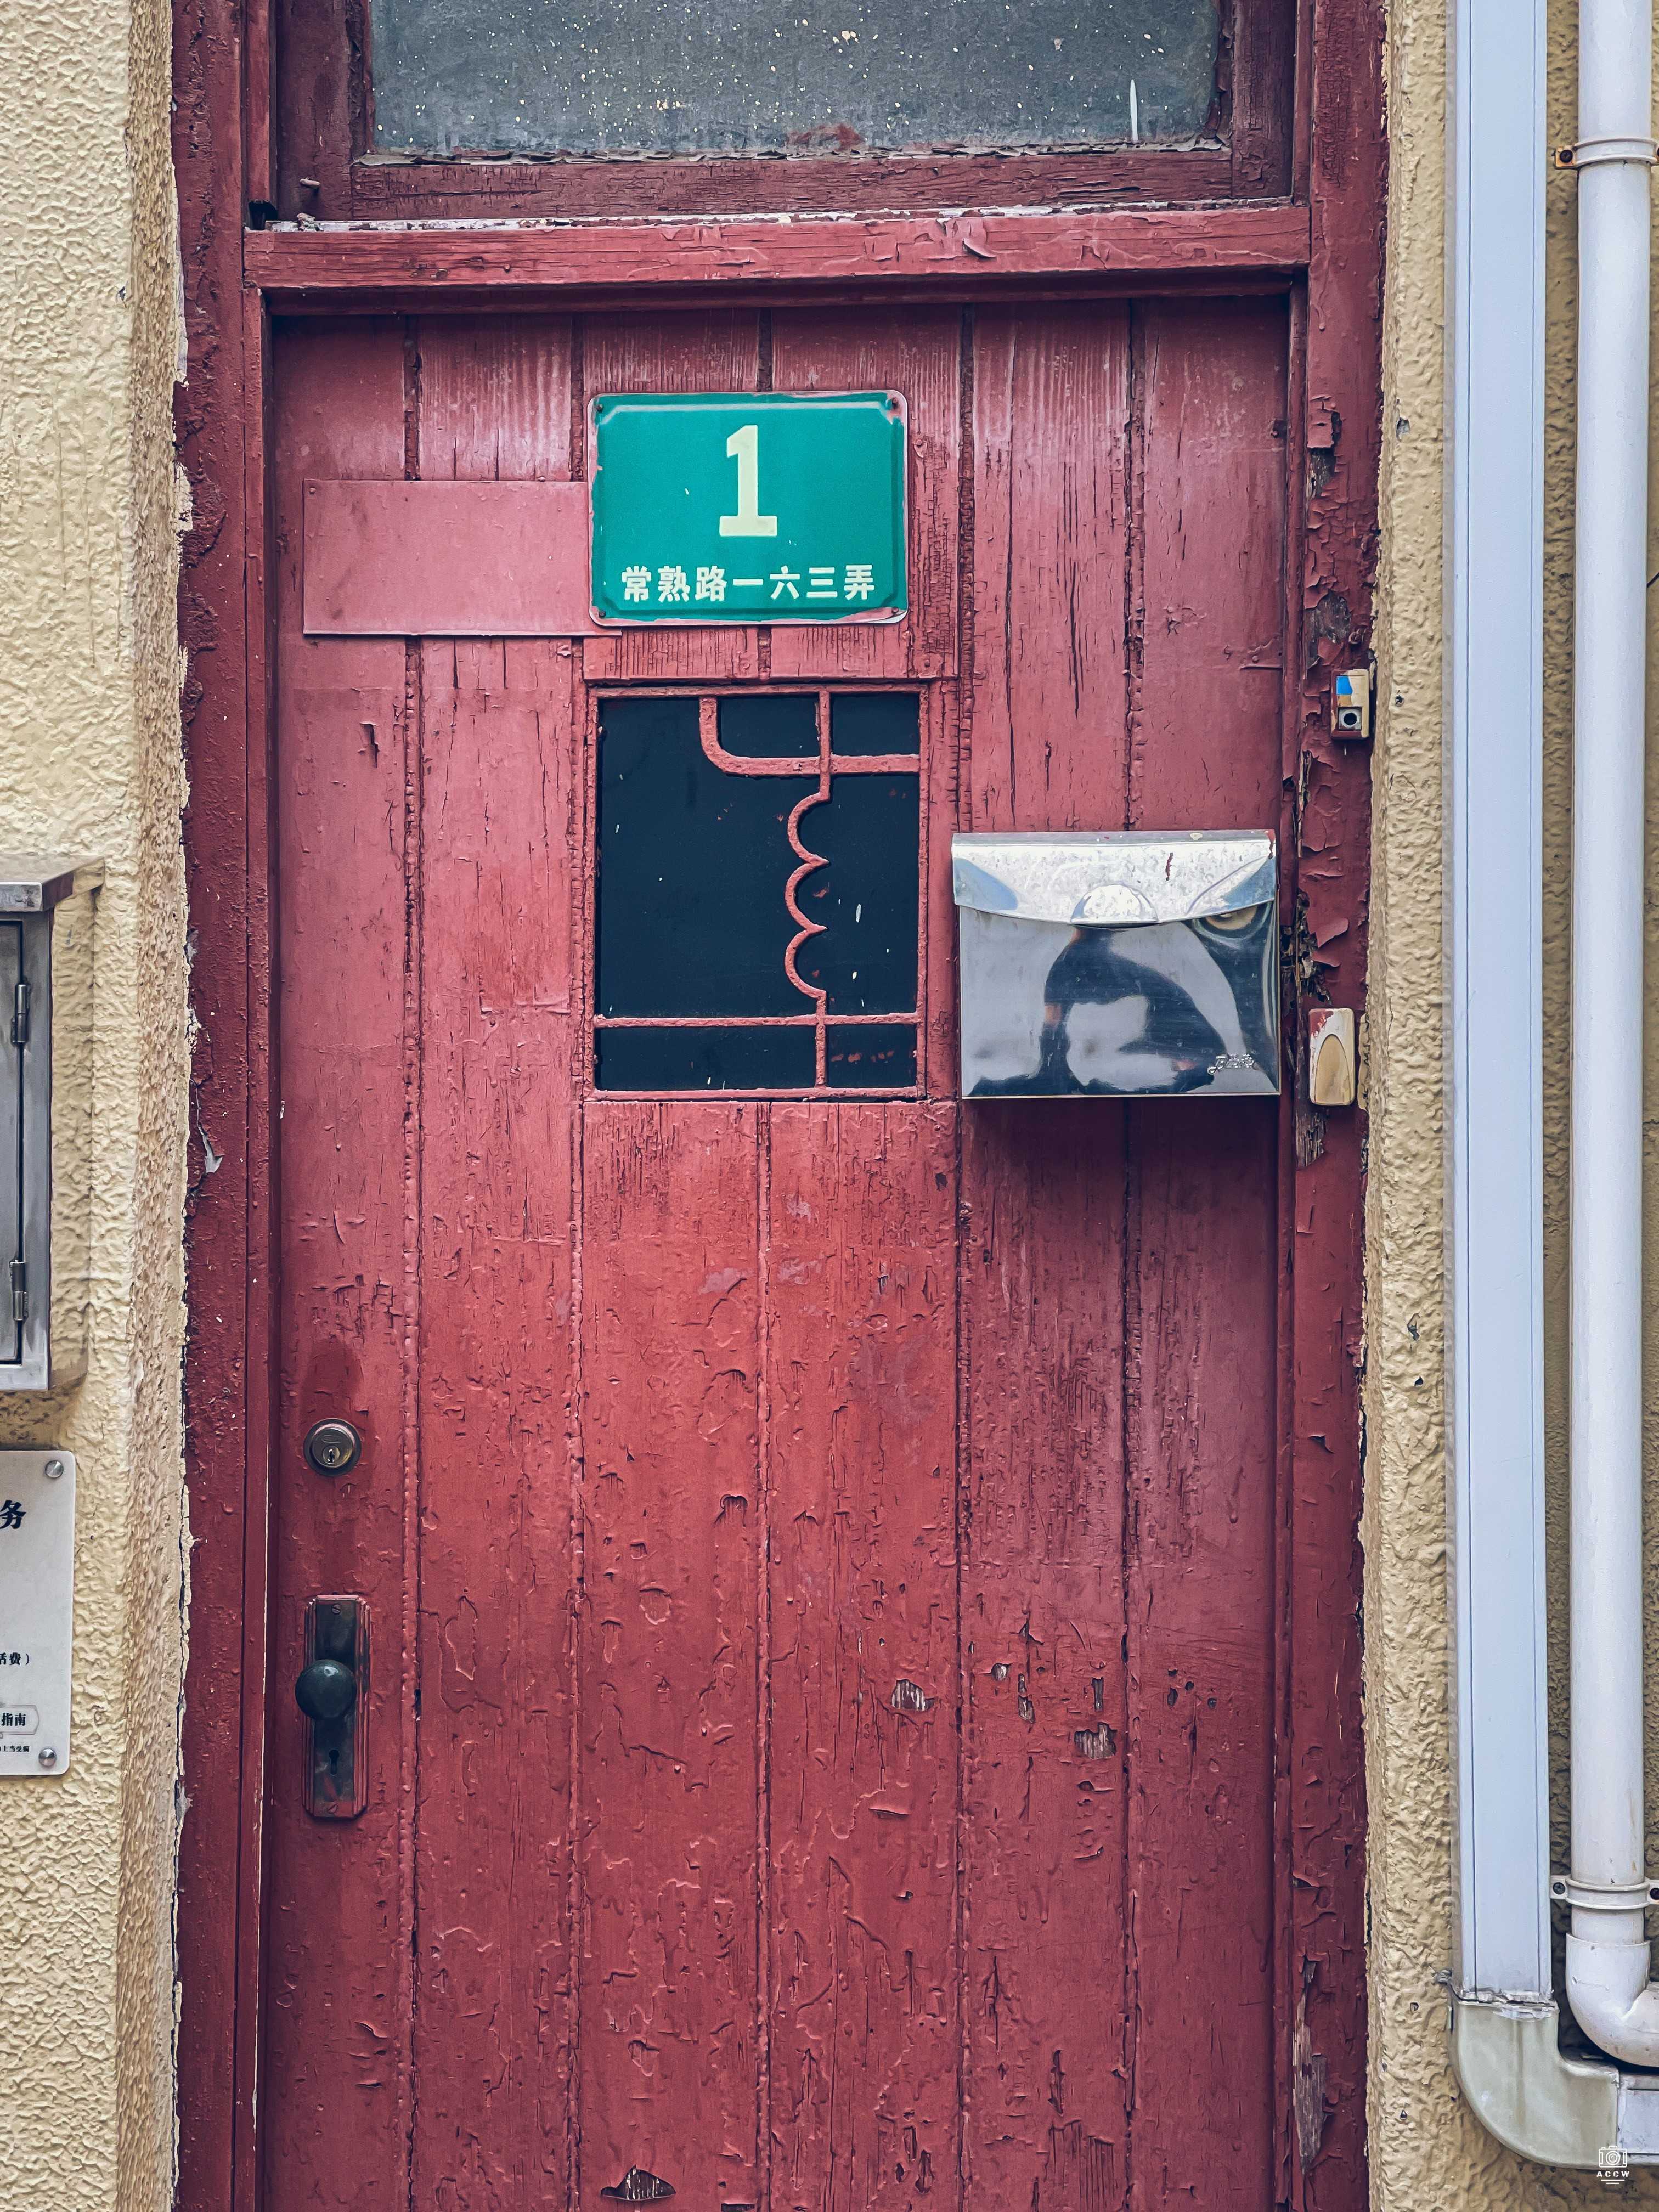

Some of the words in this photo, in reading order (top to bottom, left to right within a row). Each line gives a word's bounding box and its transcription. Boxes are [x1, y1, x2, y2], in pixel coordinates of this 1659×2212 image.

[719, 425, 778, 537] 1
[621, 564, 875, 602] 常熟路一六三弄
[2, 1713, 26, 1726] 指南
